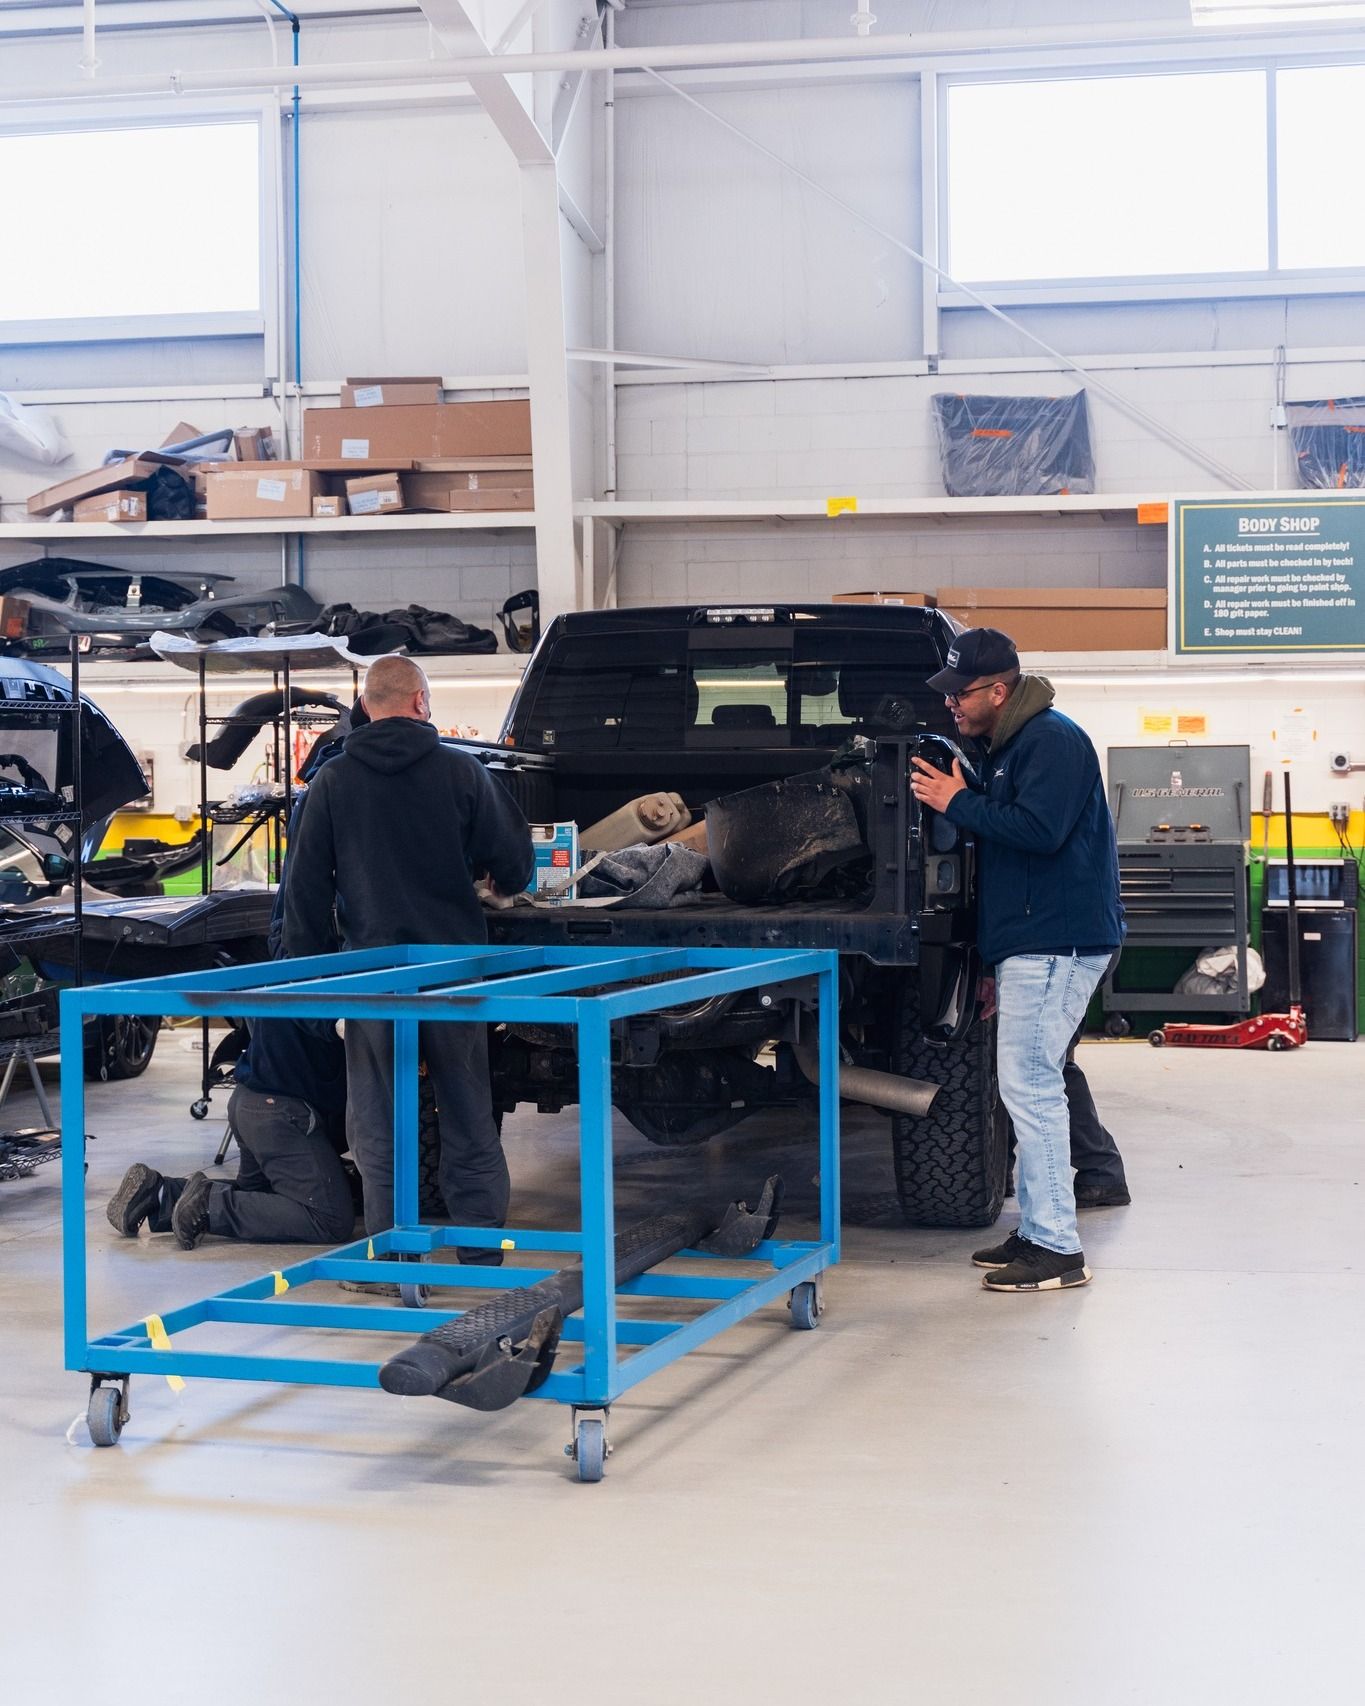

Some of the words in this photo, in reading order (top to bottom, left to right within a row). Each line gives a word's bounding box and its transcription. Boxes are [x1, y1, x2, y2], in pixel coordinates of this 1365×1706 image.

[1239, 517, 1278, 532] BODY
[1280, 516, 1320, 531] SHOP
[1203, 544, 1212, 552] A.
[1215, 544, 1226, 552] All
[1227, 544, 1253, 552] tickets
[1274, 543, 1285, 551] be
[1286, 543, 1304, 551] read
[1305, 542, 1350, 552] completely!
[1204, 560, 1212, 568] B.
[1215, 560, 1226, 568] All
[1227, 560, 1247, 569] parts
[1249, 559, 1268, 567] must
[1269, 559, 1279, 567] be
[1280, 558, 1313, 566] checked
[1314, 558, 1322, 566] in
[1323, 558, 1332, 567] by
[1333, 557, 1353, 565] tech!
[1204, 575, 1212, 583] C.
[1215, 575, 1226, 583] All
[1227, 575, 1250, 584] repair
[1251, 574, 1270, 582] work
[1271, 574, 1290, 582] must
[1291, 574, 1301, 582] be
[1302, 573, 1335, 581] checked
[1336, 573, 1346, 583] by
[1213, 585, 1247, 594] manager
[1248, 584, 1267, 594] prior
[1267, 584, 1276, 592] to
[1276, 583, 1299, 593] going
[1299, 583, 1308, 591] to
[1309, 583, 1329, 593] paint
[1330, 583, 1352, 592] shop.
[1204, 600, 1213, 608] D.
[1215, 600, 1226, 608] All
[1227, 600, 1250, 609] repair
[1251, 598, 1270, 607] work
[1271, 598, 1290, 607] must
[1291, 598, 1302, 607] be
[1302, 598, 1334, 607] finished
[1335, 598, 1346, 606] off
[1348, 598, 1356, 606] in
[1214, 609, 1229, 618] 180
[1230, 609, 1244, 618] grit
[1245, 610, 1269, 619] paper.
[1204, 628, 1212, 636] E.
[1215, 628, 1235, 637] Shop
[1236, 628, 1255, 636] must
[1256, 627, 1273, 637] stay
[1273, 627, 1302, 636] CLEAN!
